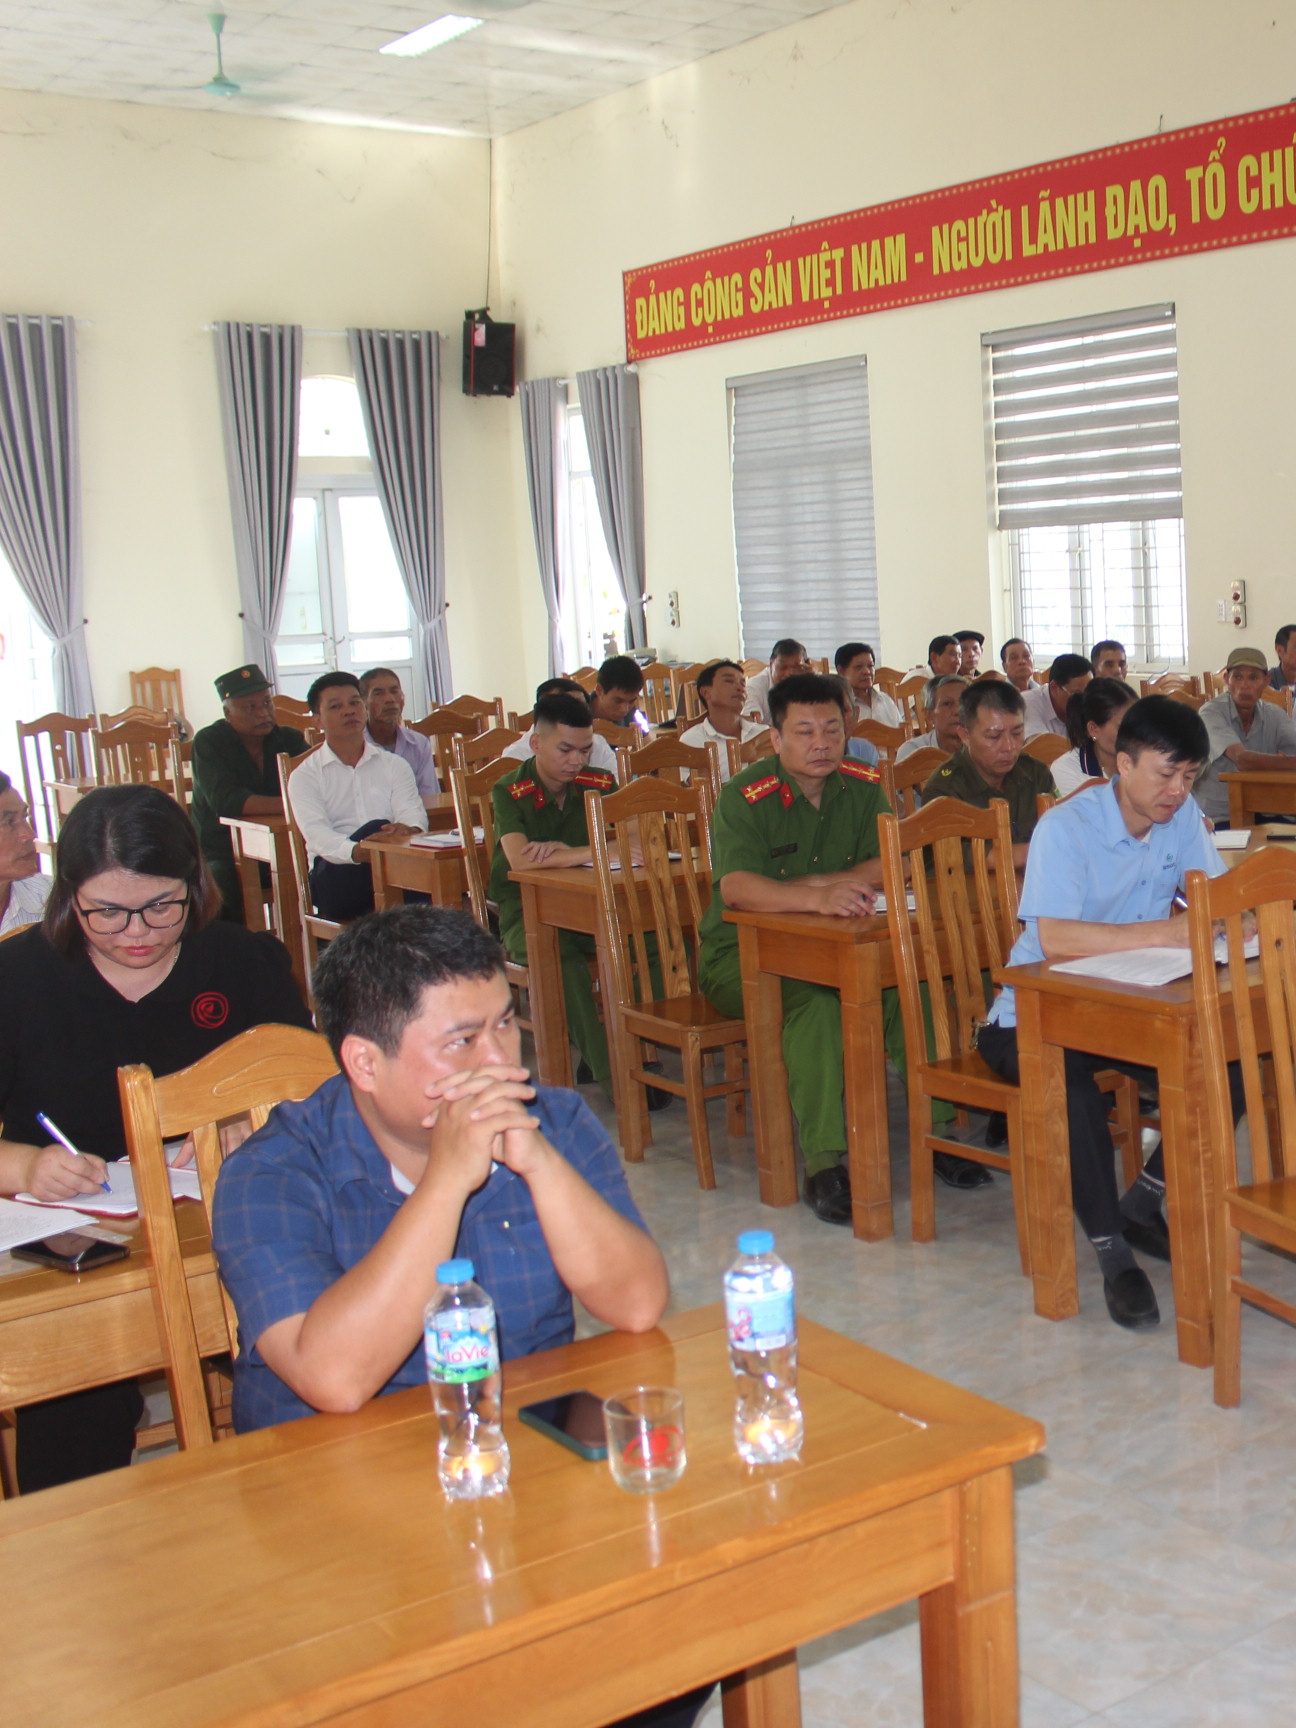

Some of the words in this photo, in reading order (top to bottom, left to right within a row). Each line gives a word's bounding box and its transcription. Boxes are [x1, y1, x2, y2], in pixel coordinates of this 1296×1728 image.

[635, 279, 685, 339] ĐẢNG
[690, 271, 744, 333] CỘNG
[750, 250, 793, 312] SẢN
[798, 241, 845, 308] VIỆT
[852, 233, 907, 291] NAM
[931, 203, 1013, 274] NGƯỜI
[1021, 181, 1096, 256] LÃNH
[1105, 175, 1177, 248] ĐẠO,
[1186, 137, 1226, 223] TỔ
